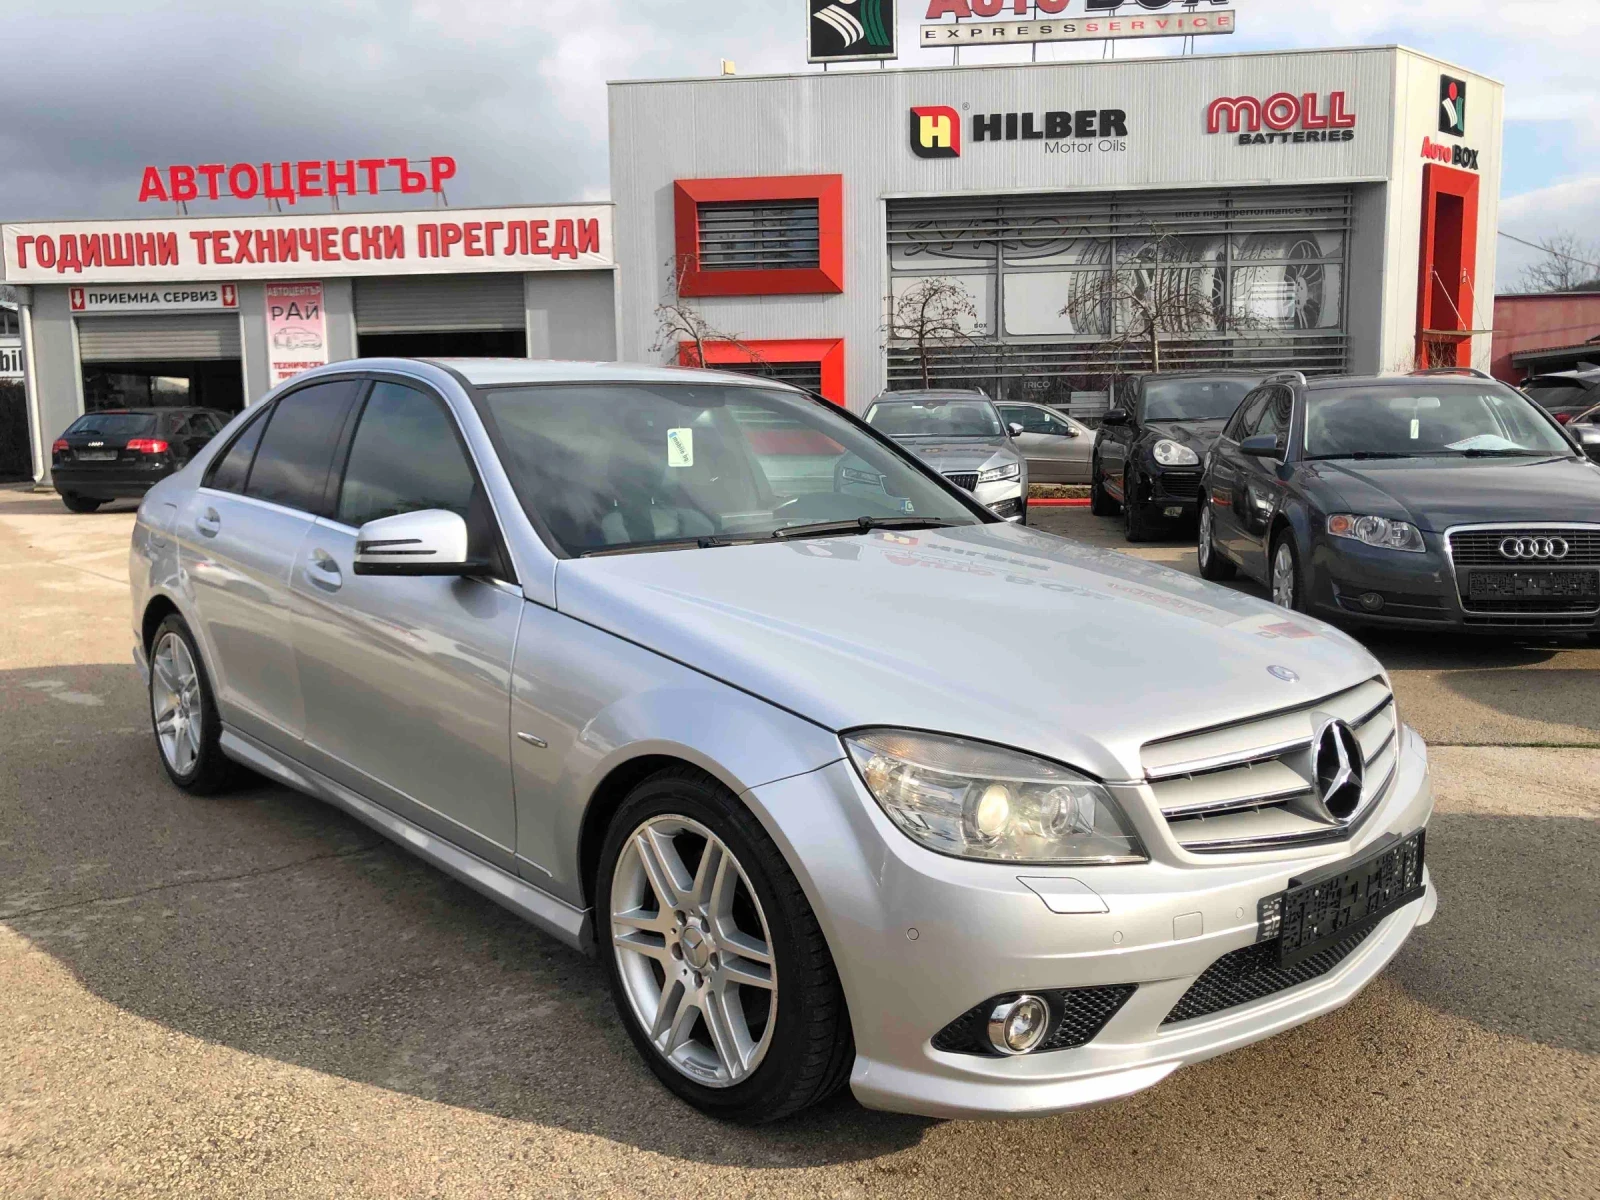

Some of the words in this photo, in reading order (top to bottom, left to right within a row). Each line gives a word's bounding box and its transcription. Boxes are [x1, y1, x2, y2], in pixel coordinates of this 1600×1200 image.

[973, 109, 1128, 141] HILBER
[1238, 129, 1355, 145] BATTERIES
[1045, 141, 1093, 154] Motor
[1098, 140, 1127, 152] Oils
[138, 156, 457, 205] АВТОЦЕНТЪР
[16, 232, 179, 274] ГОДИШНИ
[190, 225, 405, 265] ТЕХНИЧЕСКИ
[418, 218, 600, 260] ПРЕГЛЕДИ
[89, 293, 160, 304] ПРИЕМНА
[163, 291, 218, 302] СЕРВИЗ
[267, 286, 321, 297] АВТОЦЕНТЪР
[271, 301, 320, 321] РАЙ
[1023, 381, 1051, 389] TRICO
